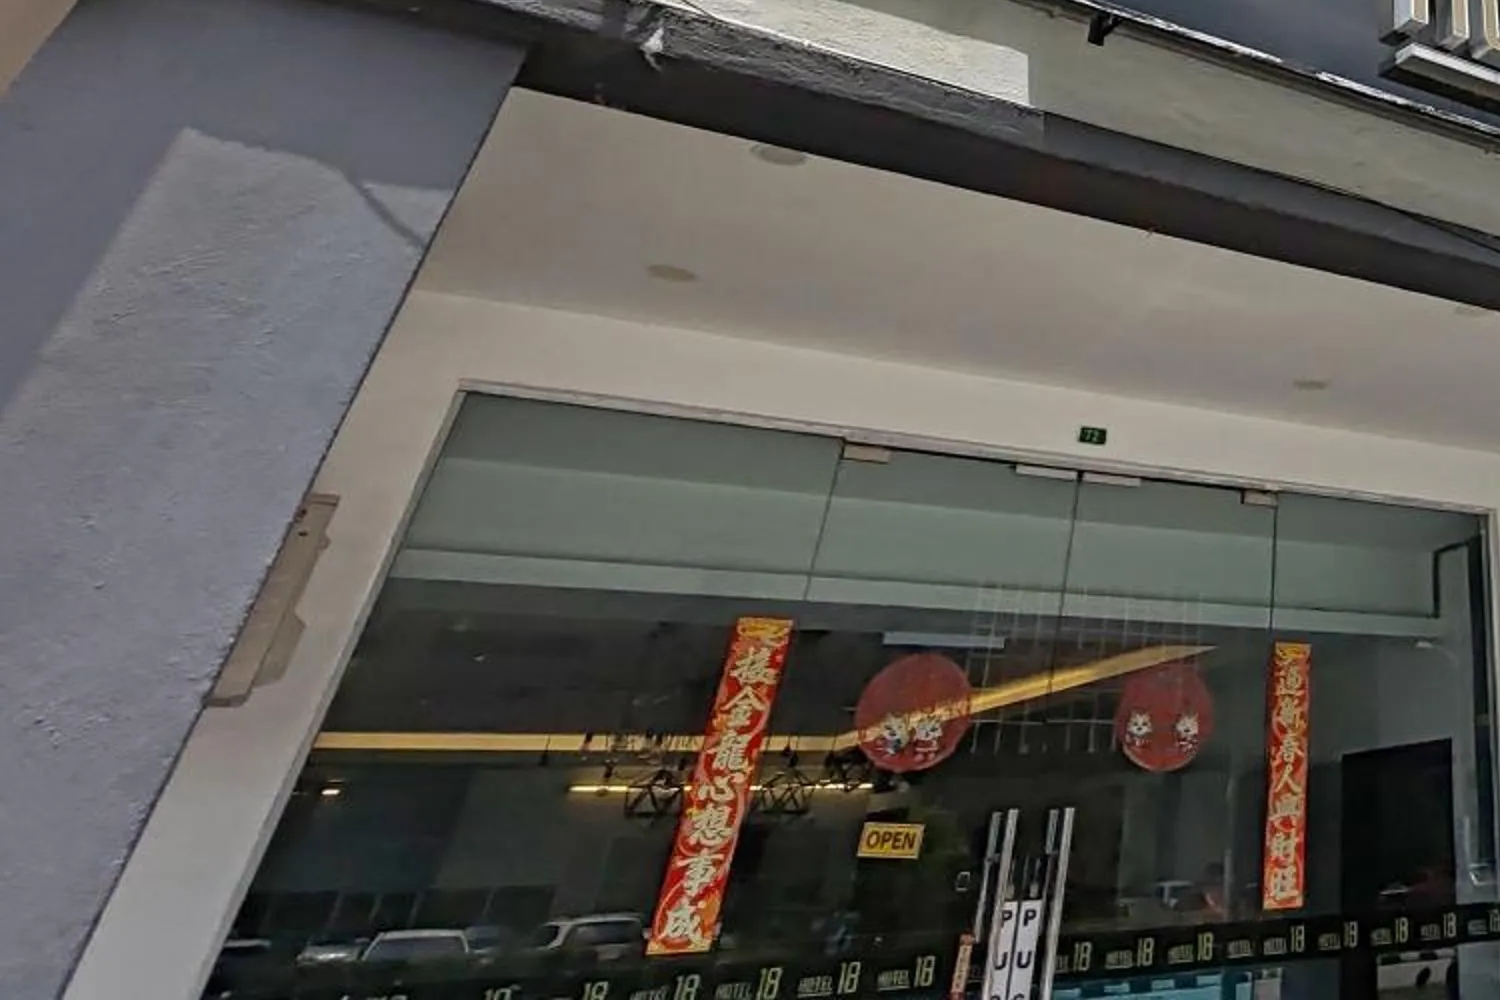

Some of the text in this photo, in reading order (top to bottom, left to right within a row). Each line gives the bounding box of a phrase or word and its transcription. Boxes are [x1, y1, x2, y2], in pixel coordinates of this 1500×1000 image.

[866, 830, 918, 850] OPEN
[1013, 909, 1037, 1000] PU
[1074, 942, 1092, 972] 18
[1136, 936, 1155, 968] 18
[1197, 931, 1214, 961] 18
[756, 966, 784, 1000] 18
[837, 961, 861, 994] 18
[913, 955, 936, 988] 18
